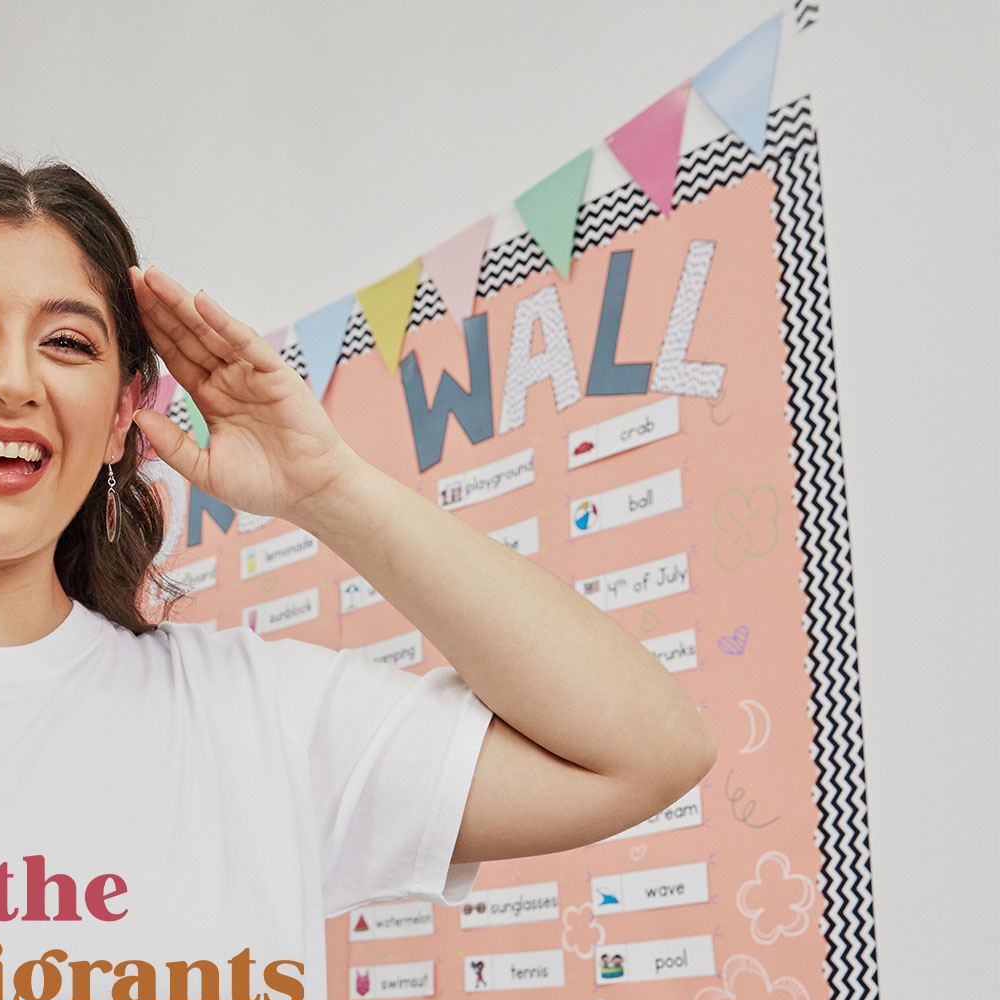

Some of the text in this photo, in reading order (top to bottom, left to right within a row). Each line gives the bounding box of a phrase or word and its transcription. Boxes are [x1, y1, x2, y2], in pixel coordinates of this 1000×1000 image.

[399, 239, 727, 474] WALL
[619, 416, 655, 442] crab
[464, 455, 534, 496] playground
[627, 488, 654, 513] ball
[265, 537, 314, 563] lemonade
[633, 571, 651, 593] of
[656, 564, 688, 587] July
[644, 881, 686, 898] wave
[490, 895, 559, 917] sunglasses
[374, 914, 432, 928] watermelon
[510, 963, 549, 981] tennis
[655, 949, 689, 974] pool
